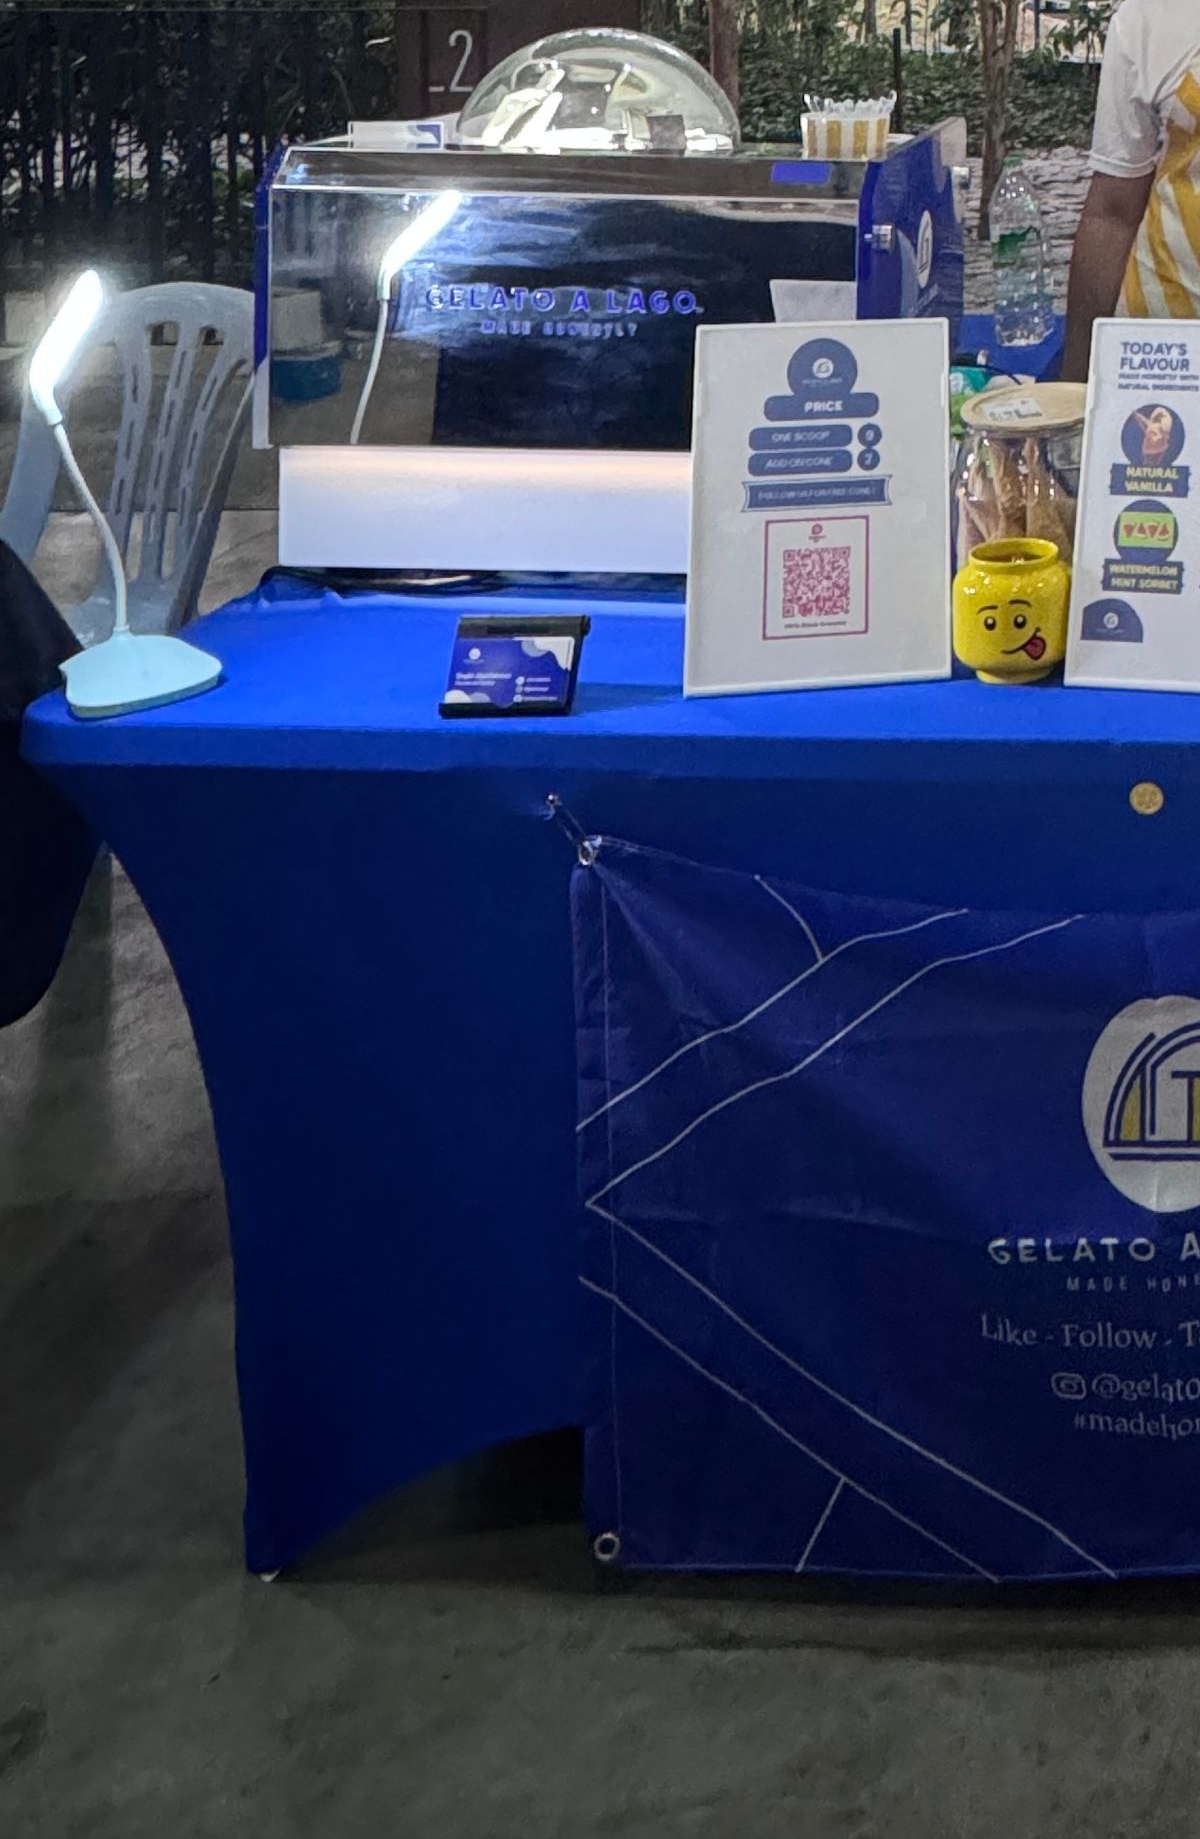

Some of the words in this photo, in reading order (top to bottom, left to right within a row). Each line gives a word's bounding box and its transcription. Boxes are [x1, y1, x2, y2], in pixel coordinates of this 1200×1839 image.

[425, 284, 556, 311] GELATO
[571, 287, 591, 312] A
[605, 288, 698, 313] LAGO
[1121, 342, 1187, 356] TODAY'S
[1120, 357, 1190, 372] FLAVOUR
[804, 400, 844, 413] PRICE
[1126, 465, 1179, 479] NATURAL
[1125, 480, 1173, 493] VANILLA
[1109, 564, 1178, 576] WATERMELON
[1111, 578, 1136, 588] MINT
[1139, 578, 1179, 590] SORBET
[986, 1237, 1156, 1264] GELATO
[1066, 1275, 1129, 1293] MADE
[980, 1312, 1038, 1346] Like
[1061, 1322, 1158, 1349] Follow
